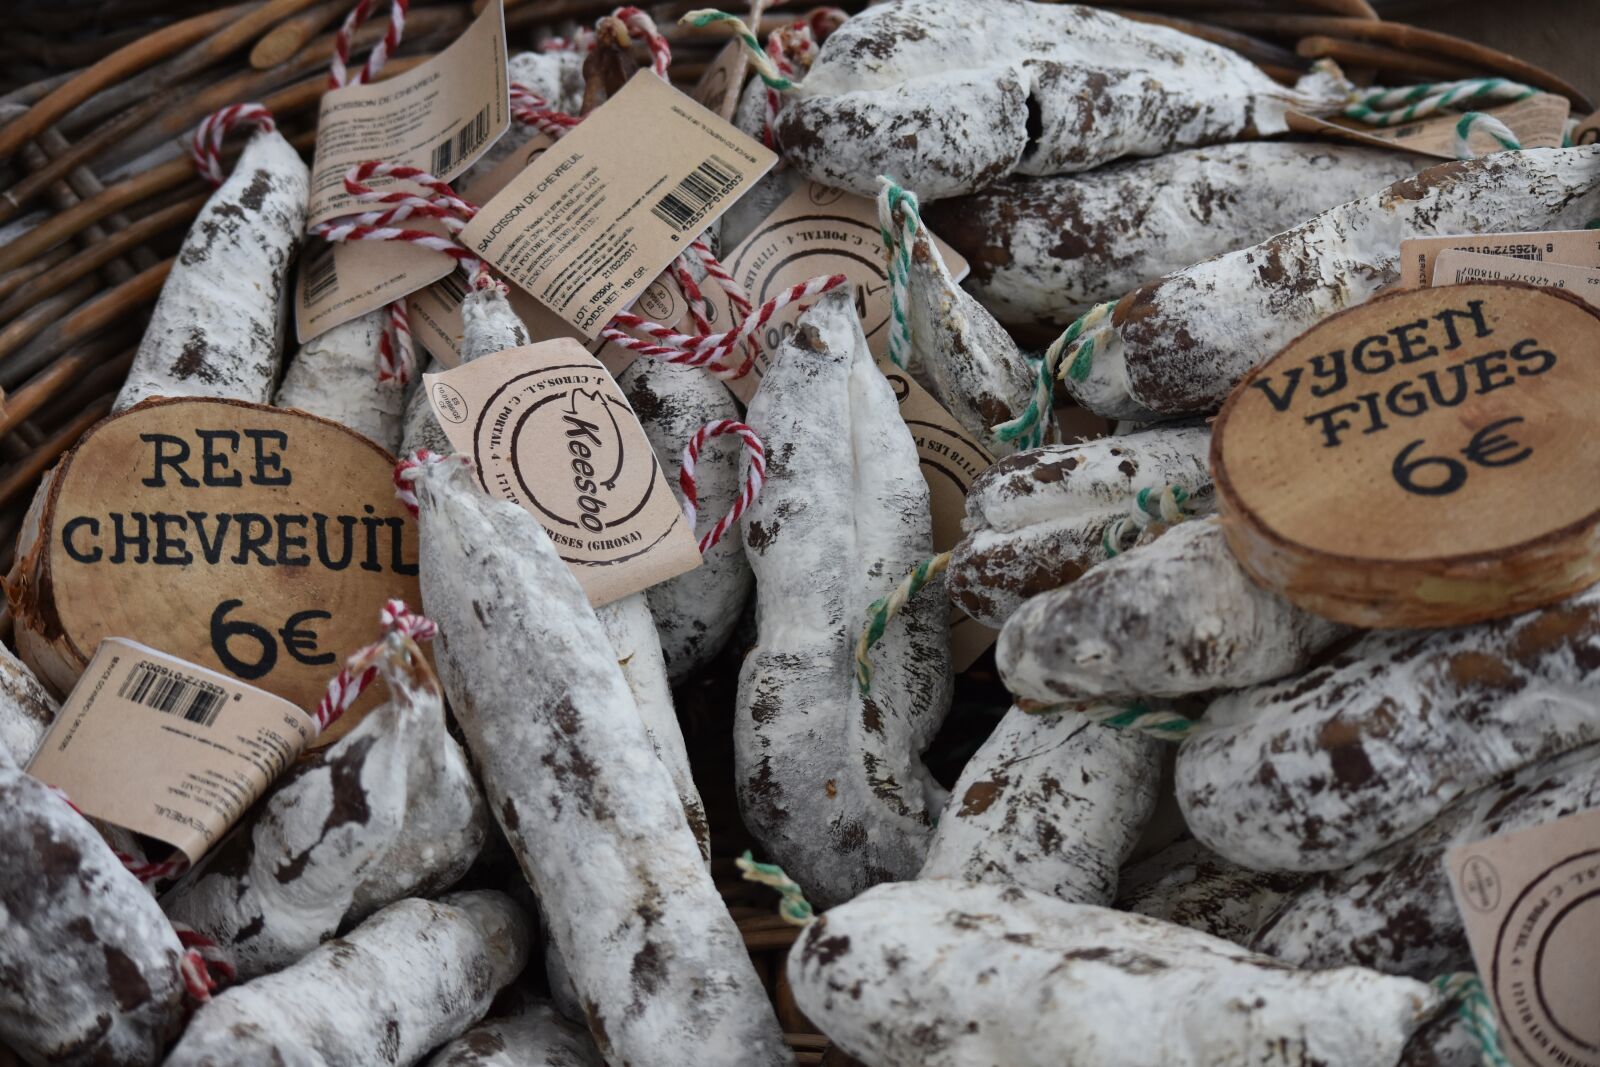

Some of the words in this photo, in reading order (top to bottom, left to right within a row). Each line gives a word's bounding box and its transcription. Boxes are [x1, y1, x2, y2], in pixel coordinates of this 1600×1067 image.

[476, 202, 526, 252] SAUCISSON
[523, 190, 539, 204] DE
[536, 151, 584, 192] CHEVREUIL
[601, 243, 638, 279] 21/02/2017
[796, 230, 848, 242] PORTAL,
[581, 305, 606, 331] POIDS
[1304, 338, 1558, 448] FIGUES
[490, 406, 513, 450] PORTAL,
[928, 440, 950, 456] LES
[140, 428, 293, 488] REE
[561, 414, 607, 533] Keesbo
[1392, 416, 1535, 496] 6€
[541, 524, 583, 549] RESES
[587, 530, 642, 551] (GIRONA)
[210, 598, 337, 680] 6€
